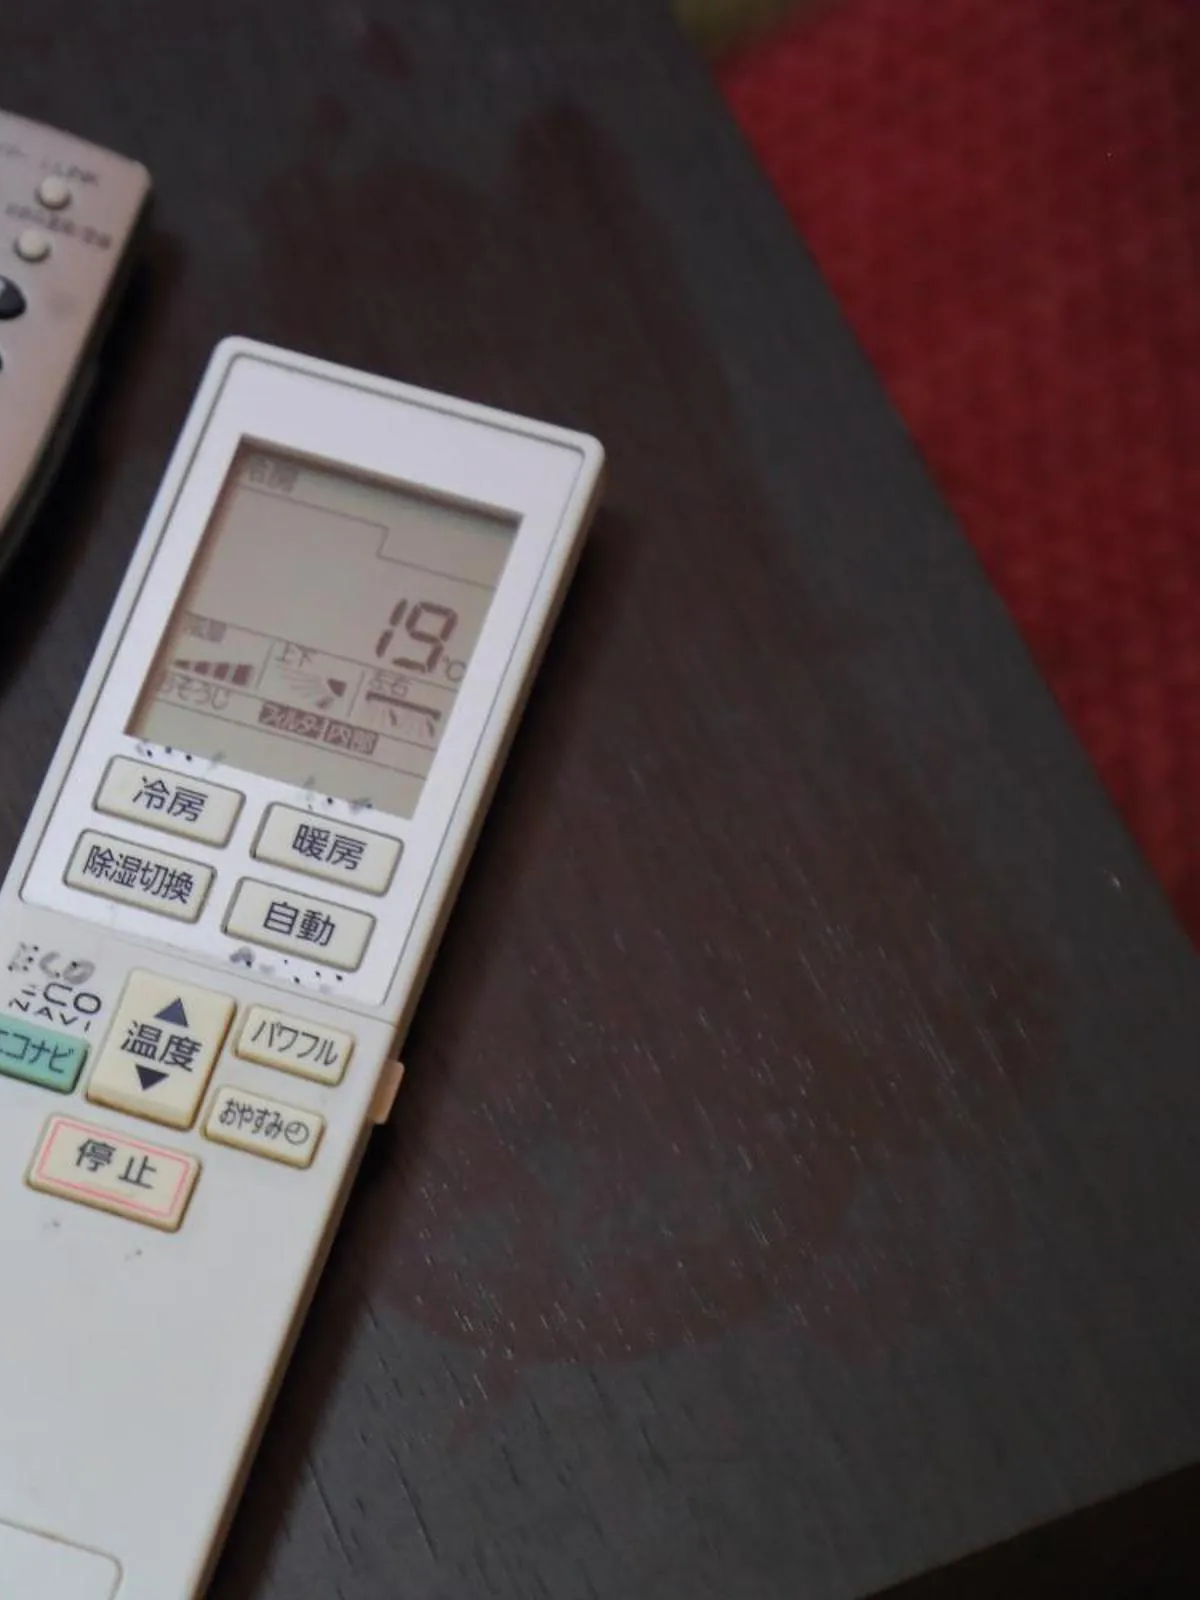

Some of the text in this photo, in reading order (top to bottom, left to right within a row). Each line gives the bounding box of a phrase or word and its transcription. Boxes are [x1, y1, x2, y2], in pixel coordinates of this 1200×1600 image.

[132, 775, 208, 823] 冷房
[291, 823, 367, 871] 暖房
[82, 844, 195, 905] 除湿切換
[263, 900, 336, 947] 自動
[8, 998, 92, 1033] NAVI
[120, 1020, 202, 1073] 温度
[251, 1020, 338, 1067] パワフル
[218, 1098, 284, 1140] おやすみ
[75, 1138, 158, 1189] 停止
